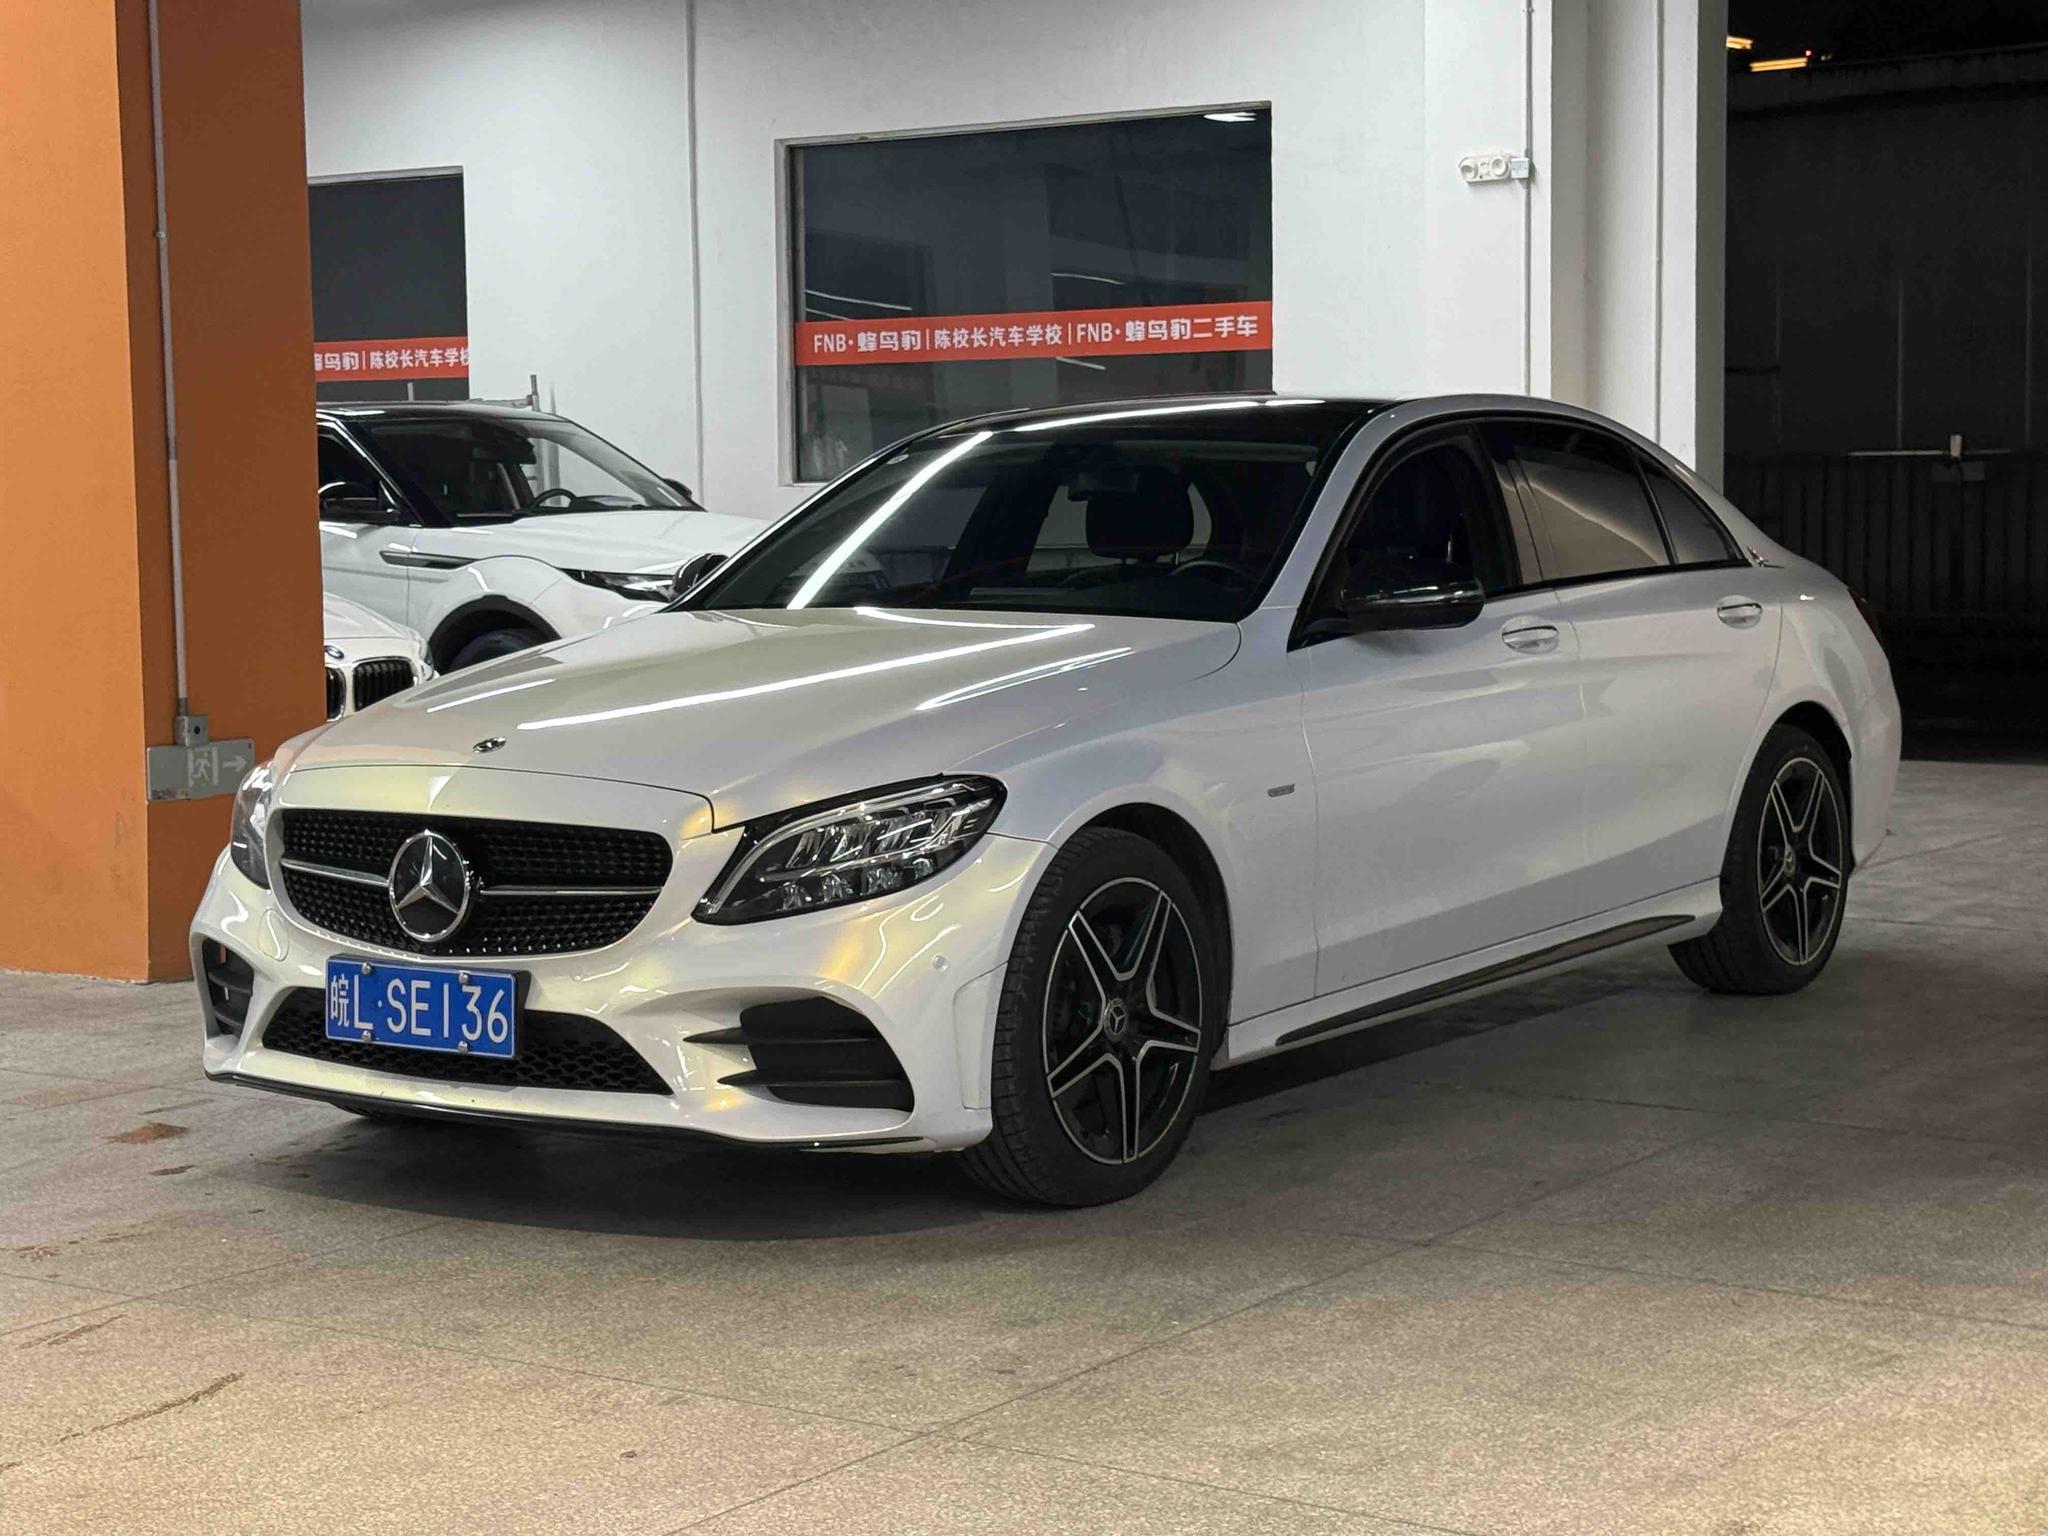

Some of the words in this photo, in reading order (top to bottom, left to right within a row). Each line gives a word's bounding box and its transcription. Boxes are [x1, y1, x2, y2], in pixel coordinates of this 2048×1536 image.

[934, 324, 1062, 350] 陈校长汽车学校
